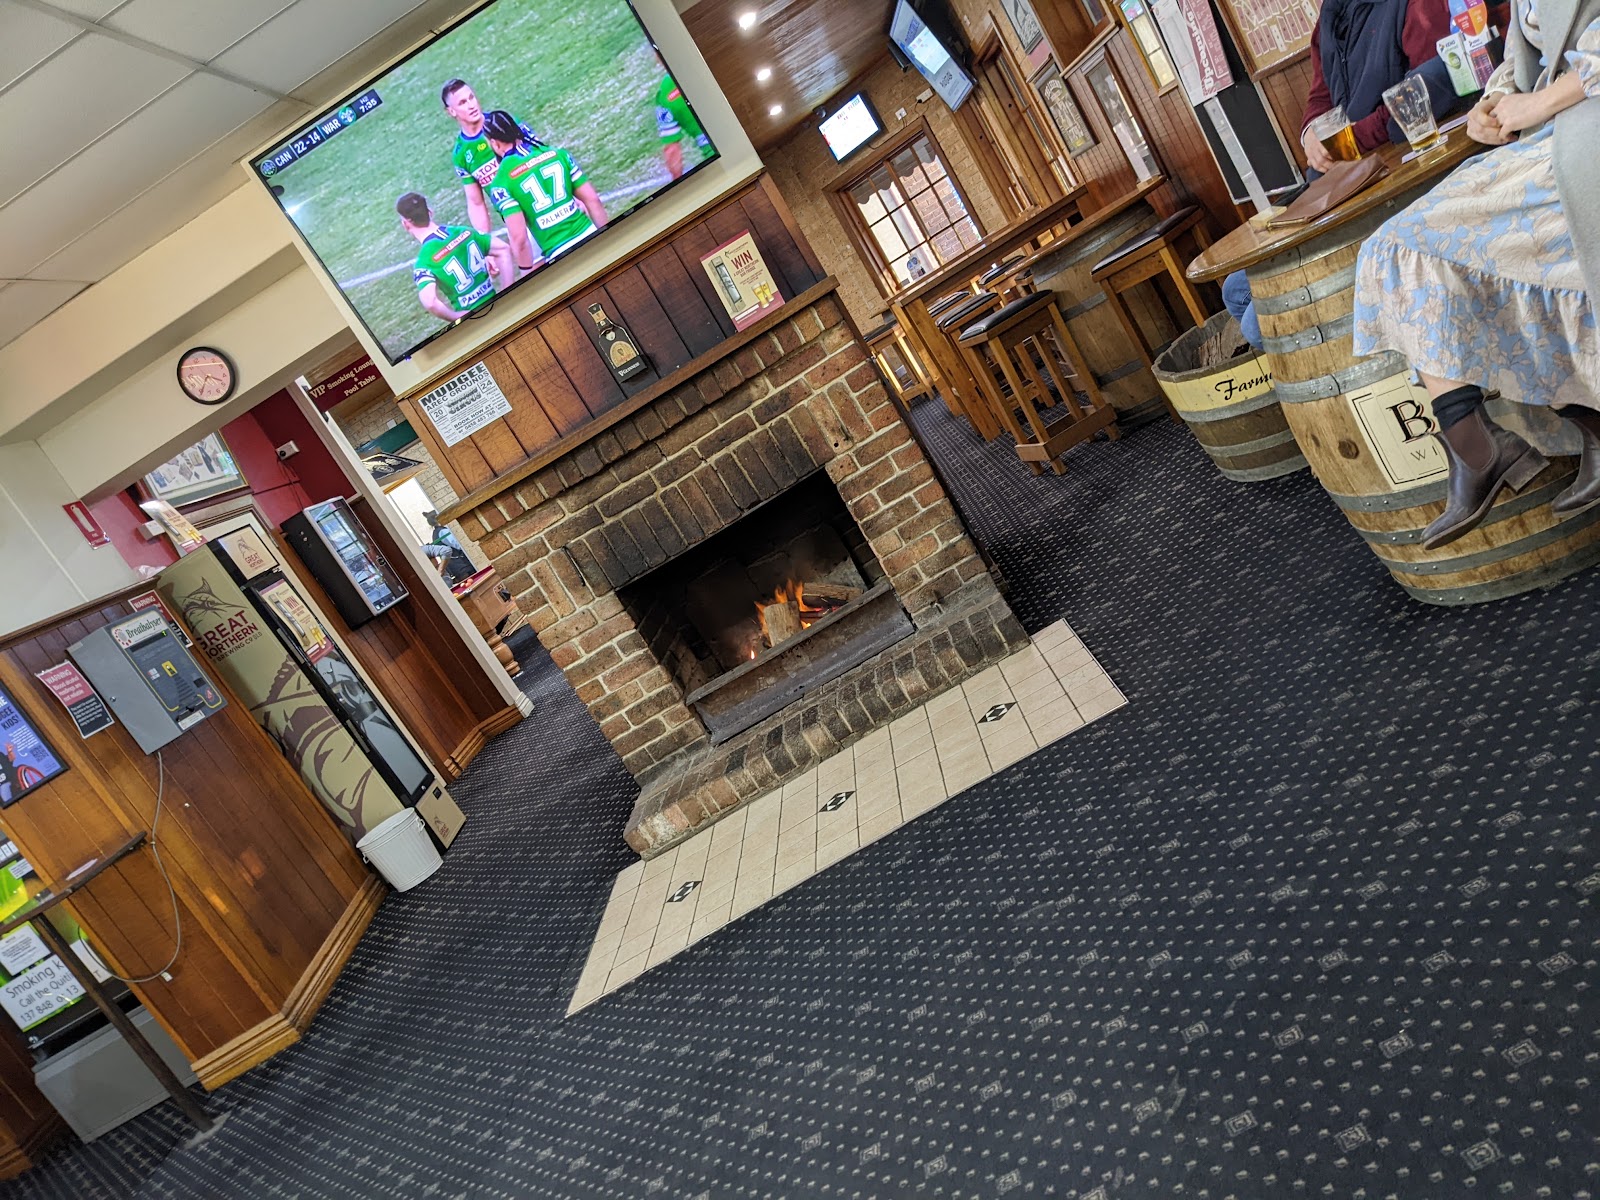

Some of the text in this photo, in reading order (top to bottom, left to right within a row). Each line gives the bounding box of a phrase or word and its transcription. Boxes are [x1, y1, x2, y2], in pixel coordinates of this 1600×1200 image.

[359, 98, 378, 113] 7:35
[274, 151, 293, 167] CAN
[321, 118, 342, 135] WAR
[520, 160, 567, 213] 17
[443, 240, 486, 294] 14
[731, 249, 753, 270] WIN
[310, 384, 326, 398] VIP
[327, 370, 355, 390] Smoking
[343, 374, 377, 396] Pool Table
[420, 363, 487, 407] MUDGEE
[426, 396, 449, 412] AREC
[449, 371, 490, 397] GROUNDS
[480, 380, 493, 390] 24
[433, 409, 444, 418] 20
[470, 409, 484, 419] NOW
[125, 617, 164, 639] Breathalyser
[196, 610, 249, 651] GREAT
[216, 642, 246, 662] BREWING
[45, 669, 73, 685] WARNING
[6, 966, 56, 999] Smoking
[19, 993, 36, 1008] Call
[35, 987, 50, 999] the
[20, 1009, 36, 1023] 137
[35, 1001, 54, 1014] 848
[66, 984, 79, 996] 13
